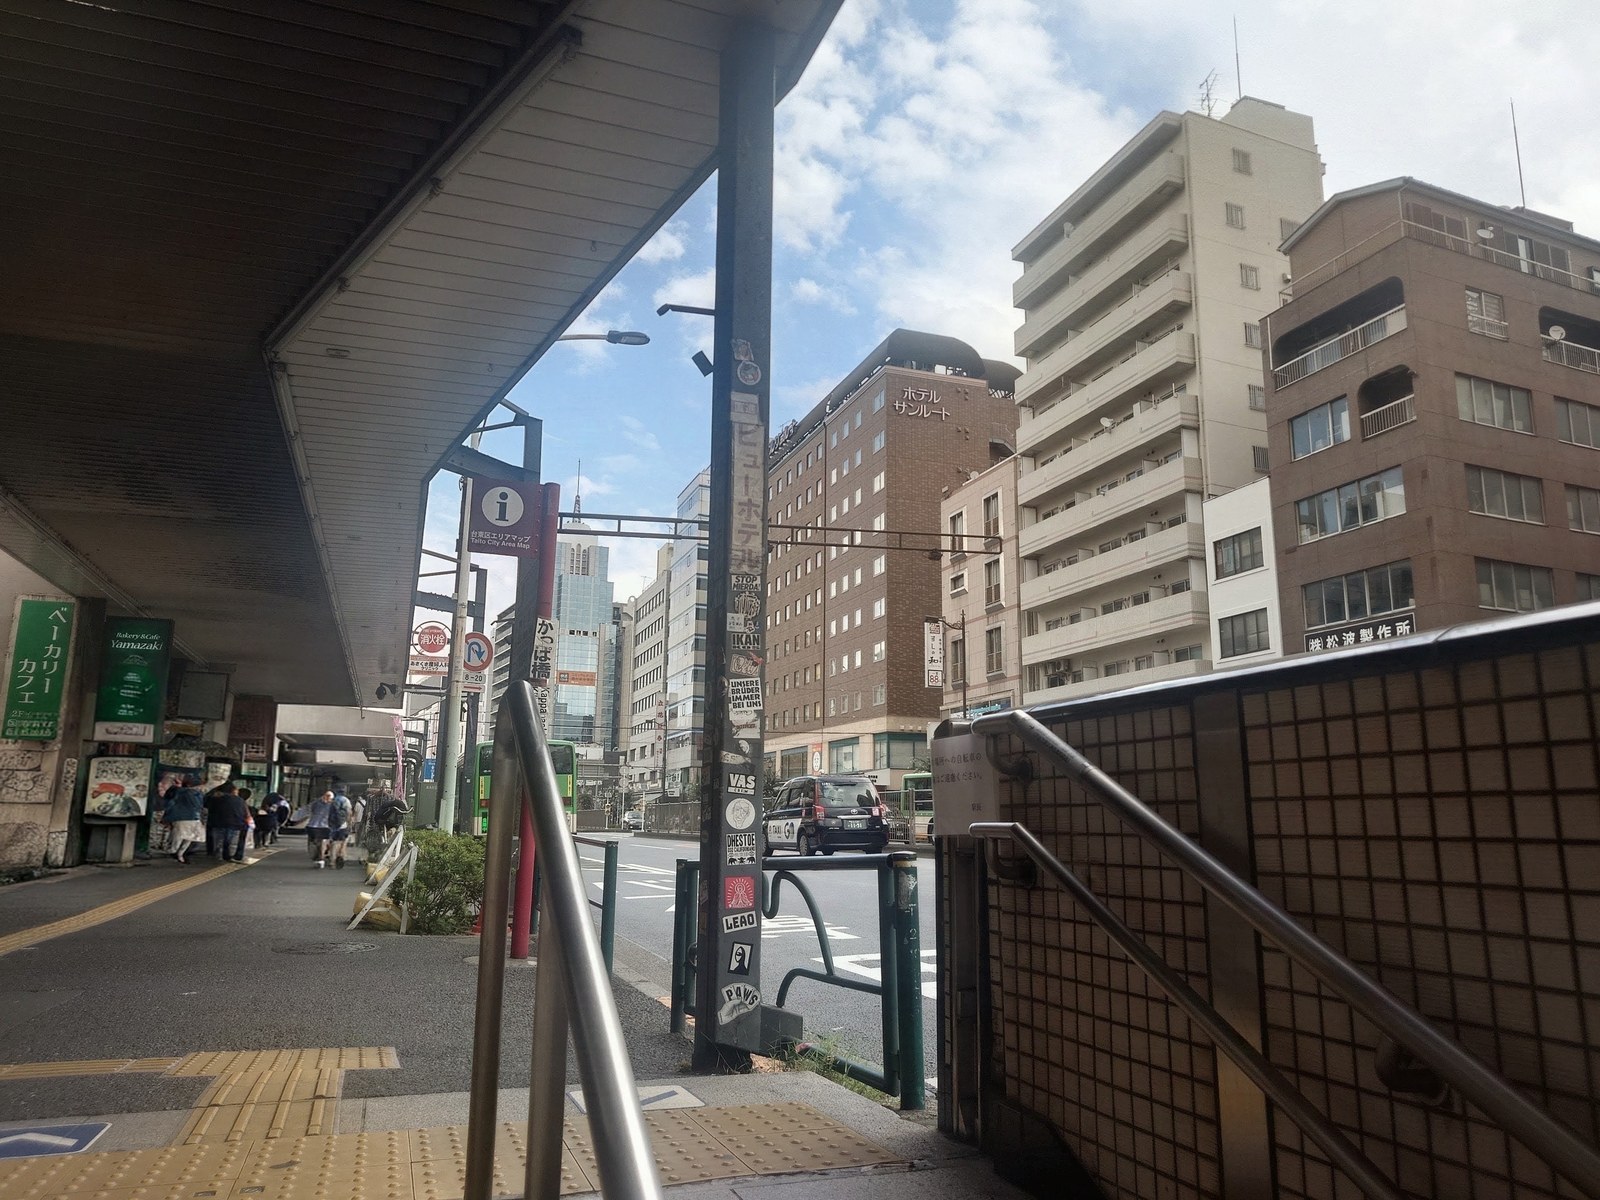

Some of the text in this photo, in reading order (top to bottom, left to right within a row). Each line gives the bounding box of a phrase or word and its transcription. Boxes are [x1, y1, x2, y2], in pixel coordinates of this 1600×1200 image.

[902, 386, 942, 404] ホテル
[893, 400, 951, 421] サンルート
[471, 530, 531, 543] 台東区エリアマップ
[471, 537, 530, 550] Taito City Area Map
[735, 575, 758, 584] STOP
[115, 632, 140, 641] Bakery
[420, 634, 445, 645] 消火栓
[732, 634, 760, 646] IKAN
[43, 607, 68, 694] ベーカリー
[111, 640, 163, 651] Yamazaki
[531, 620, 554, 680] かっぱ橋
[16, 658, 37, 704] カフェ
[464, 674, 483, 682] 8-20
[730, 680, 760, 688] UNSERE
[731, 694, 761, 702] IMMER
[729, 773, 756, 789] VAS
[727, 833, 755, 848] DHESTOE
[725, 913, 756, 931] LEAO
[725, 986, 759, 1006] PAWS
